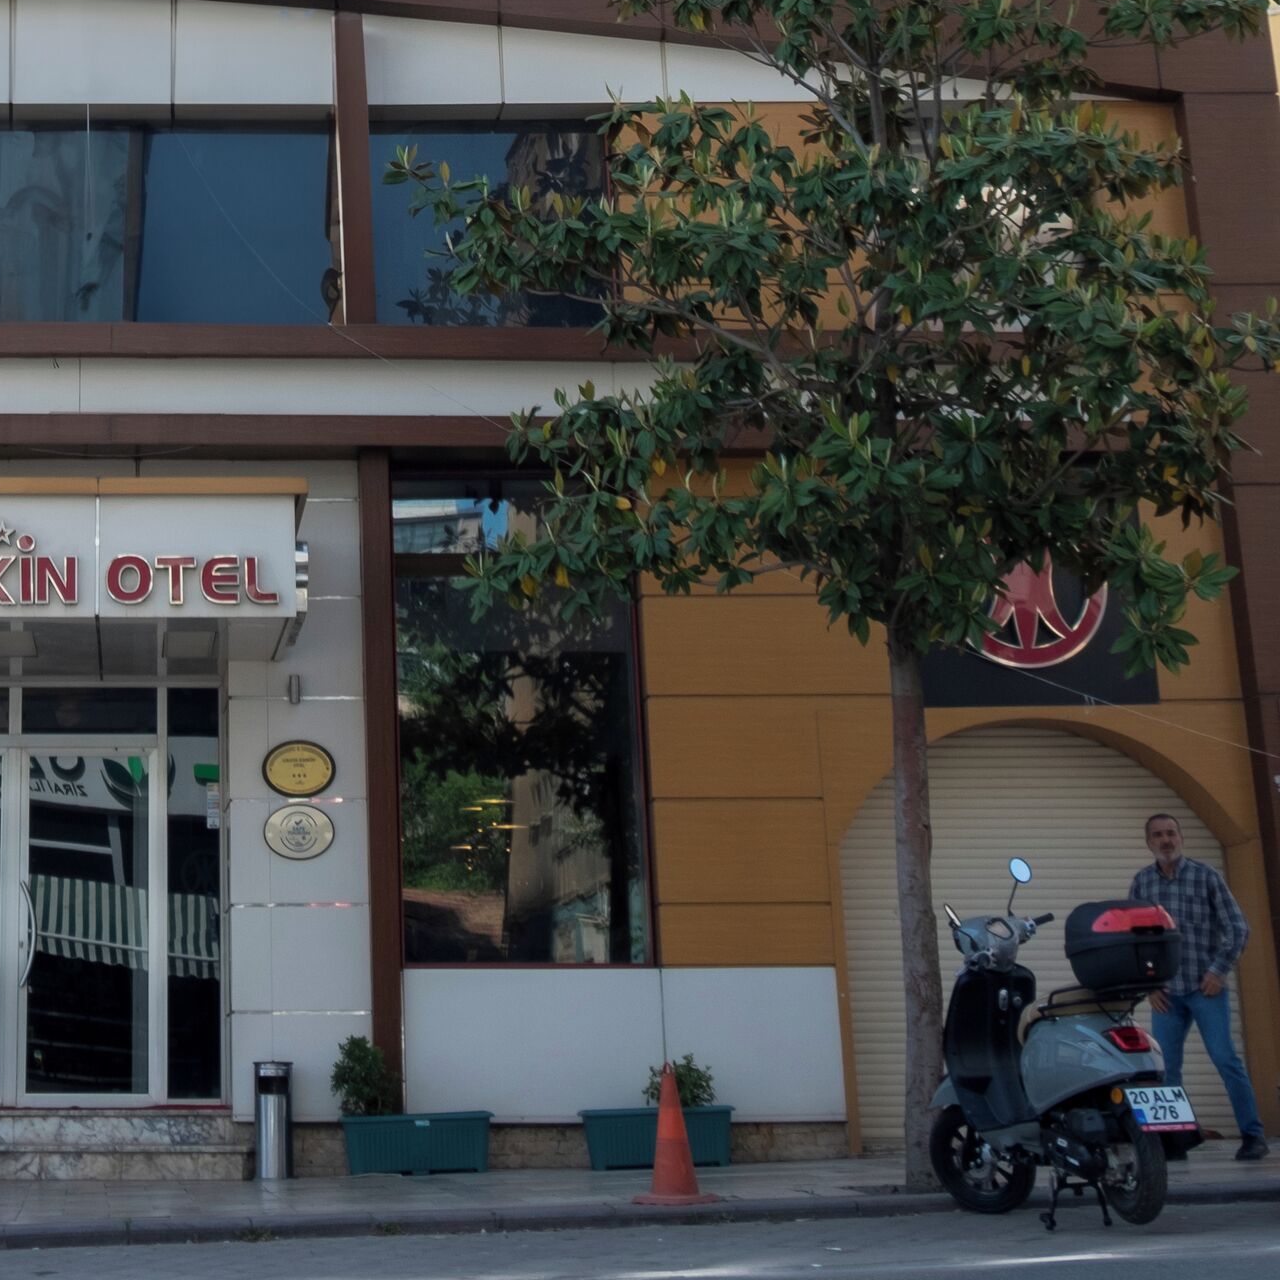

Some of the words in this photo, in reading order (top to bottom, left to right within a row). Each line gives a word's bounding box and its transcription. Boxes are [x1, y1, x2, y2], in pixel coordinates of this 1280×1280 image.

[106, 554, 279, 605] OTEL
[1129, 1090, 1150, 1104] 20
[1153, 1088, 1187, 1103] ALM
[1150, 1105, 1179, 1120] 276
